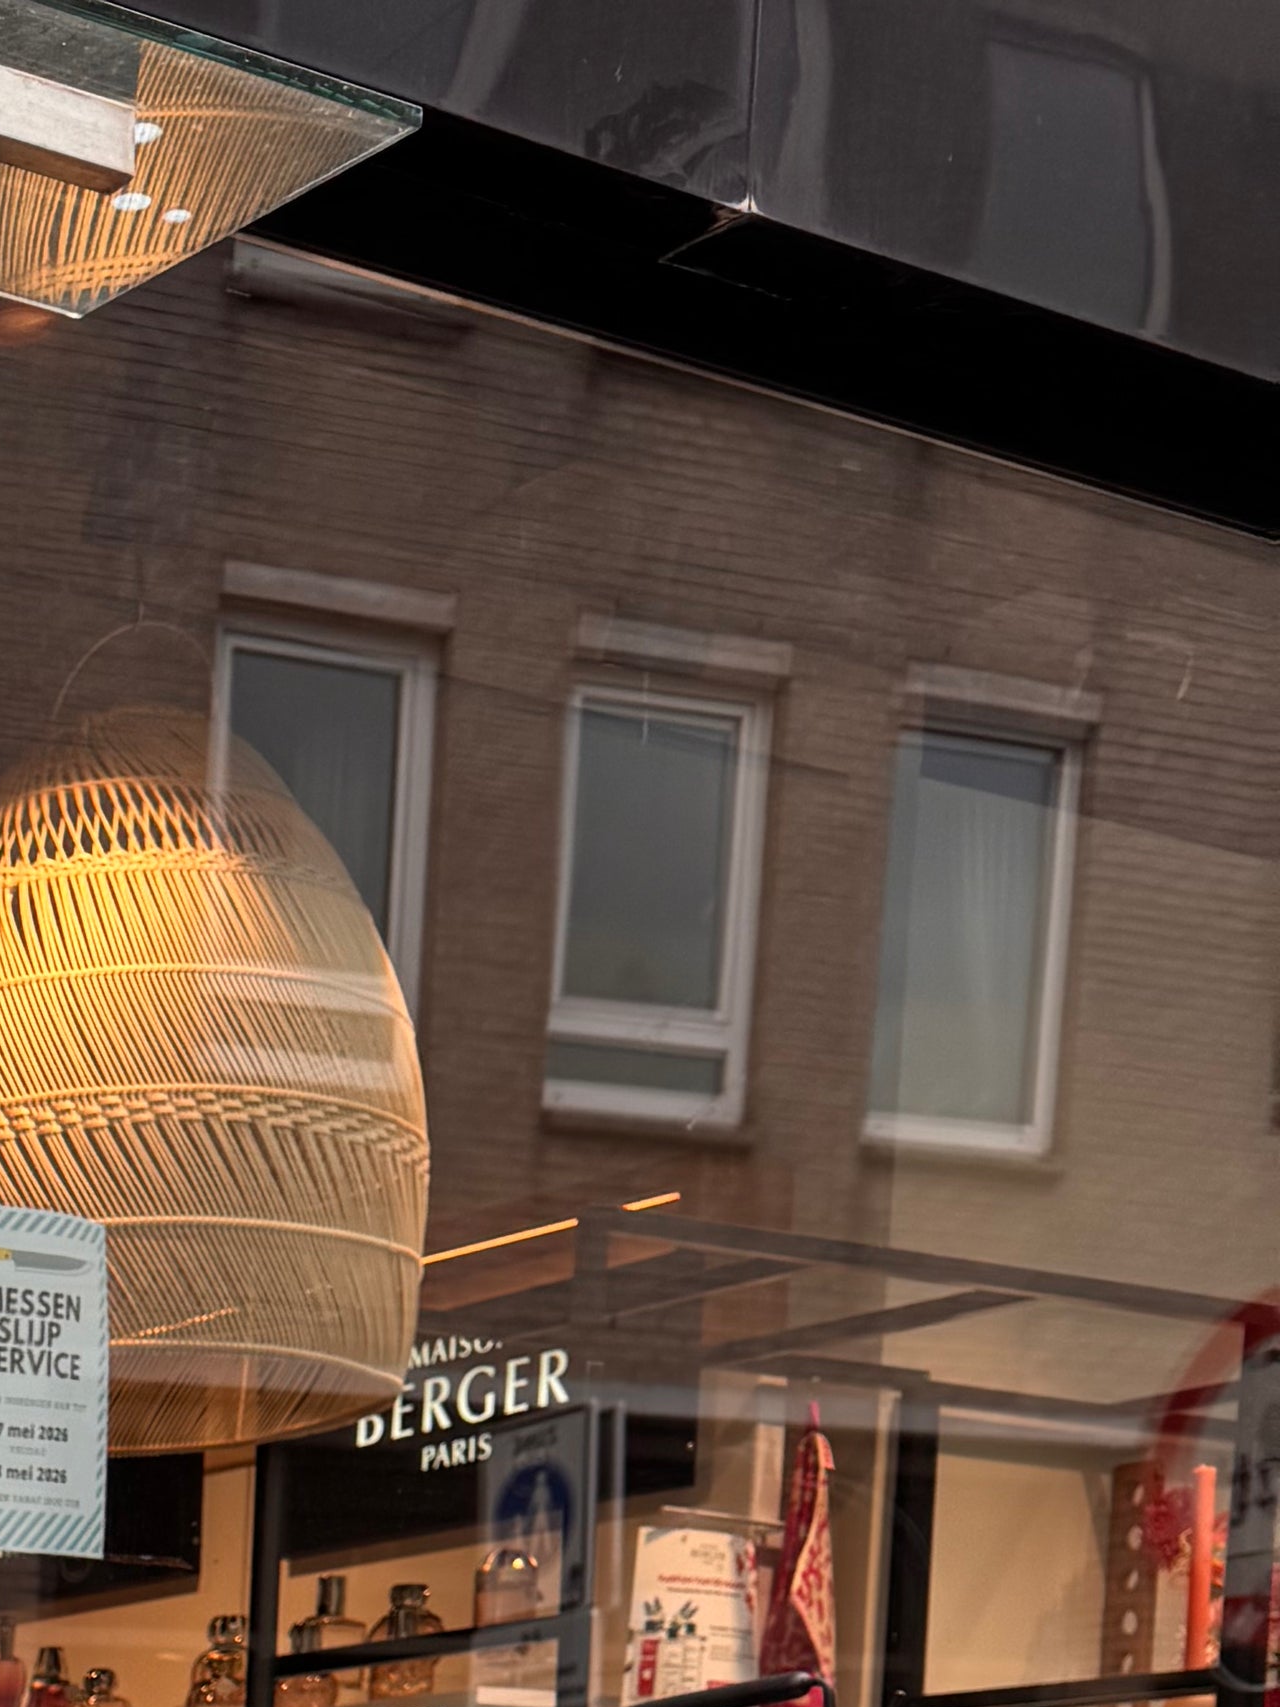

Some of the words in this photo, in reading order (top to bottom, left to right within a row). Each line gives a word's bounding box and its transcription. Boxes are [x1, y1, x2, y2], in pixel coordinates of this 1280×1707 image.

[7, 1424, 35, 1439] mei
[38, 1426, 69, 1442] 2026
[420, 1432, 493, 1472] PARIS
[6, 1465, 33, 1481] mei
[37, 1467, 68, 1484] 2026
